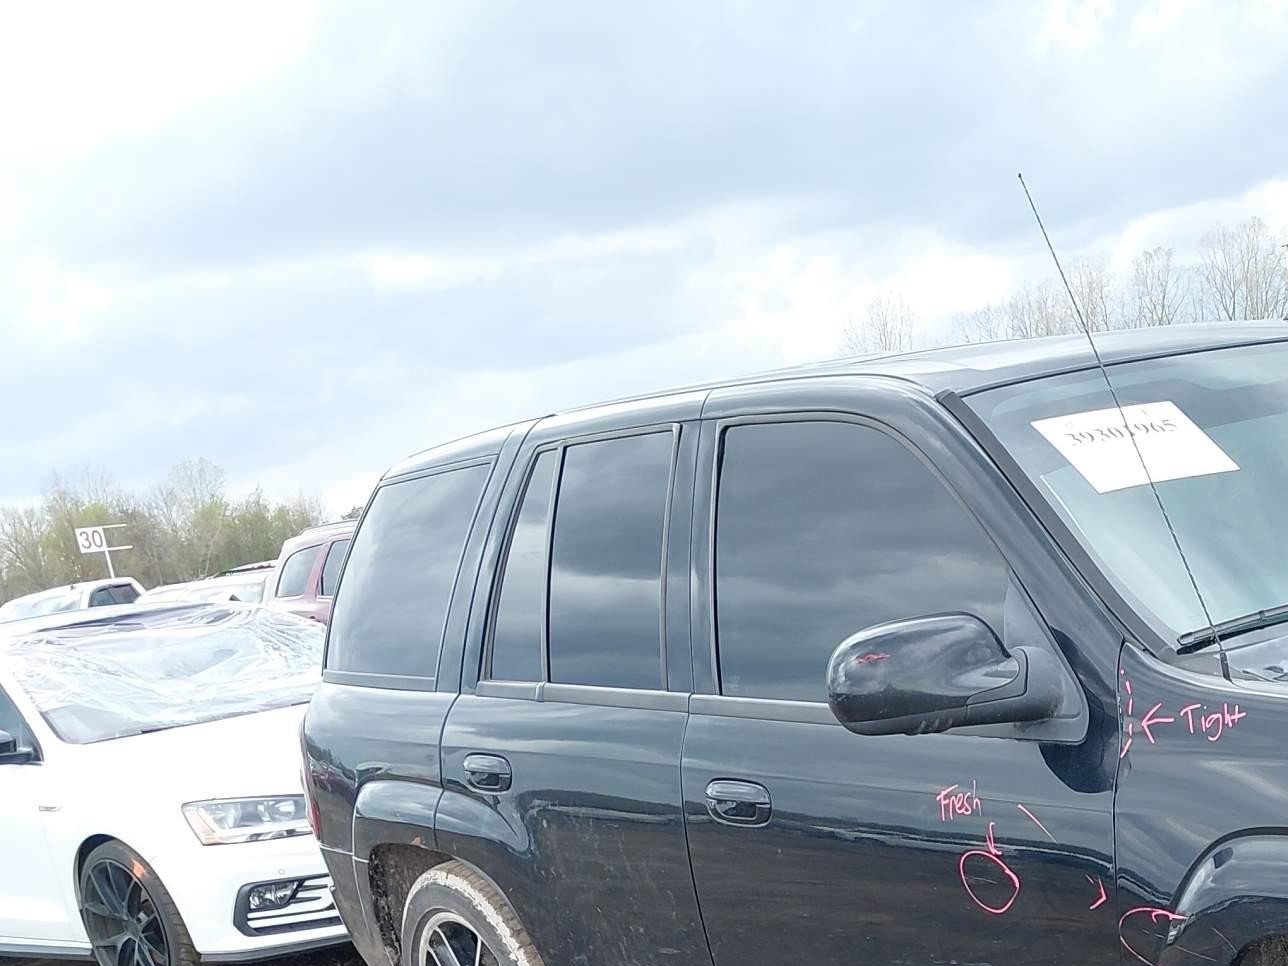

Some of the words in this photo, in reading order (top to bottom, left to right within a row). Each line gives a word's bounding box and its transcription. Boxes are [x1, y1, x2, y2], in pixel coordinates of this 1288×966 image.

[79, 530, 103, 549] 30
[1180, 703, 1247, 741] Tight
[936, 779, 982, 821] Fresh
